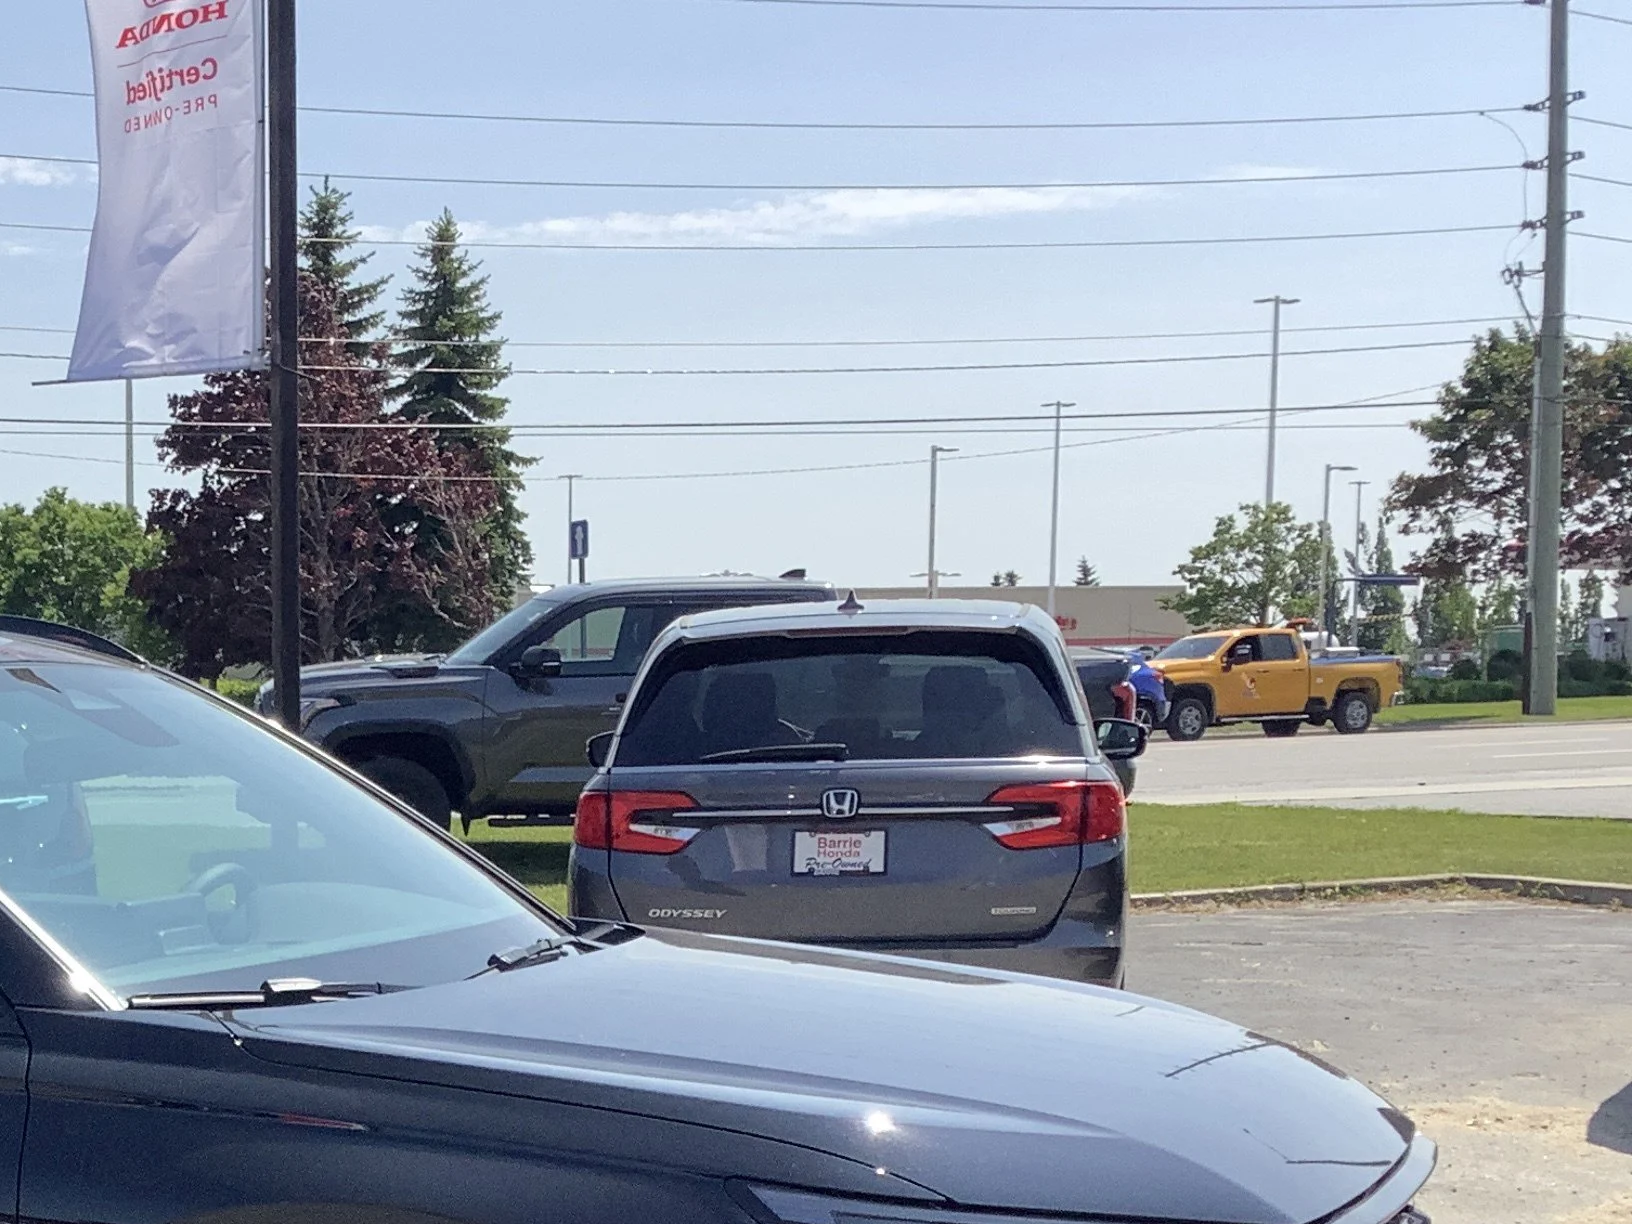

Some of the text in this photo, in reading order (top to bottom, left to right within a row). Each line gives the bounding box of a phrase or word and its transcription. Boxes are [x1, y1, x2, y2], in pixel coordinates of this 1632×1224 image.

[817, 837, 862, 849] Barrie
[817, 849, 861, 858] Honda
[648, 908, 728, 918] ODYSSEY
